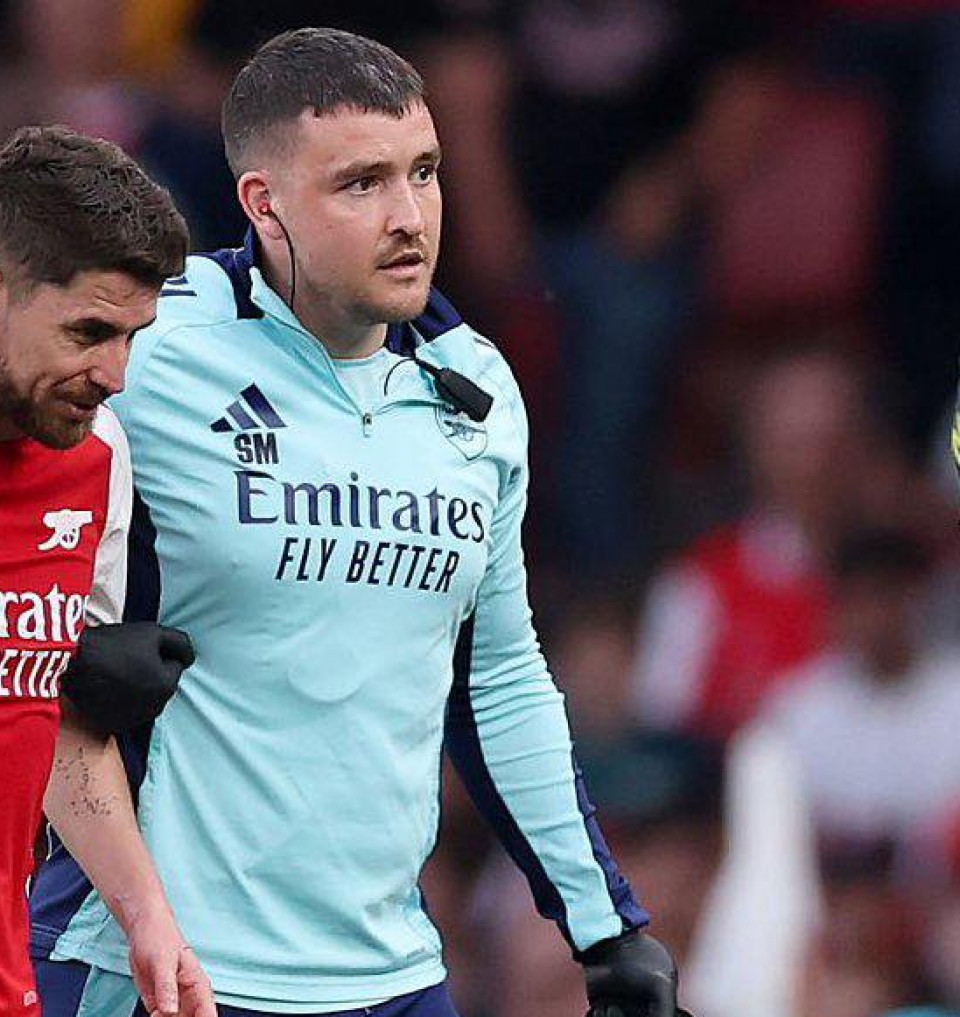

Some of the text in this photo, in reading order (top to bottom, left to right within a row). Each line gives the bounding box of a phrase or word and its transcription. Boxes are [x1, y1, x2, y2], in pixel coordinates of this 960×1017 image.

[234, 432, 279, 464] SM
[233, 470, 485, 543] Emirates
[275, 537, 460, 593] FLY BETTER
